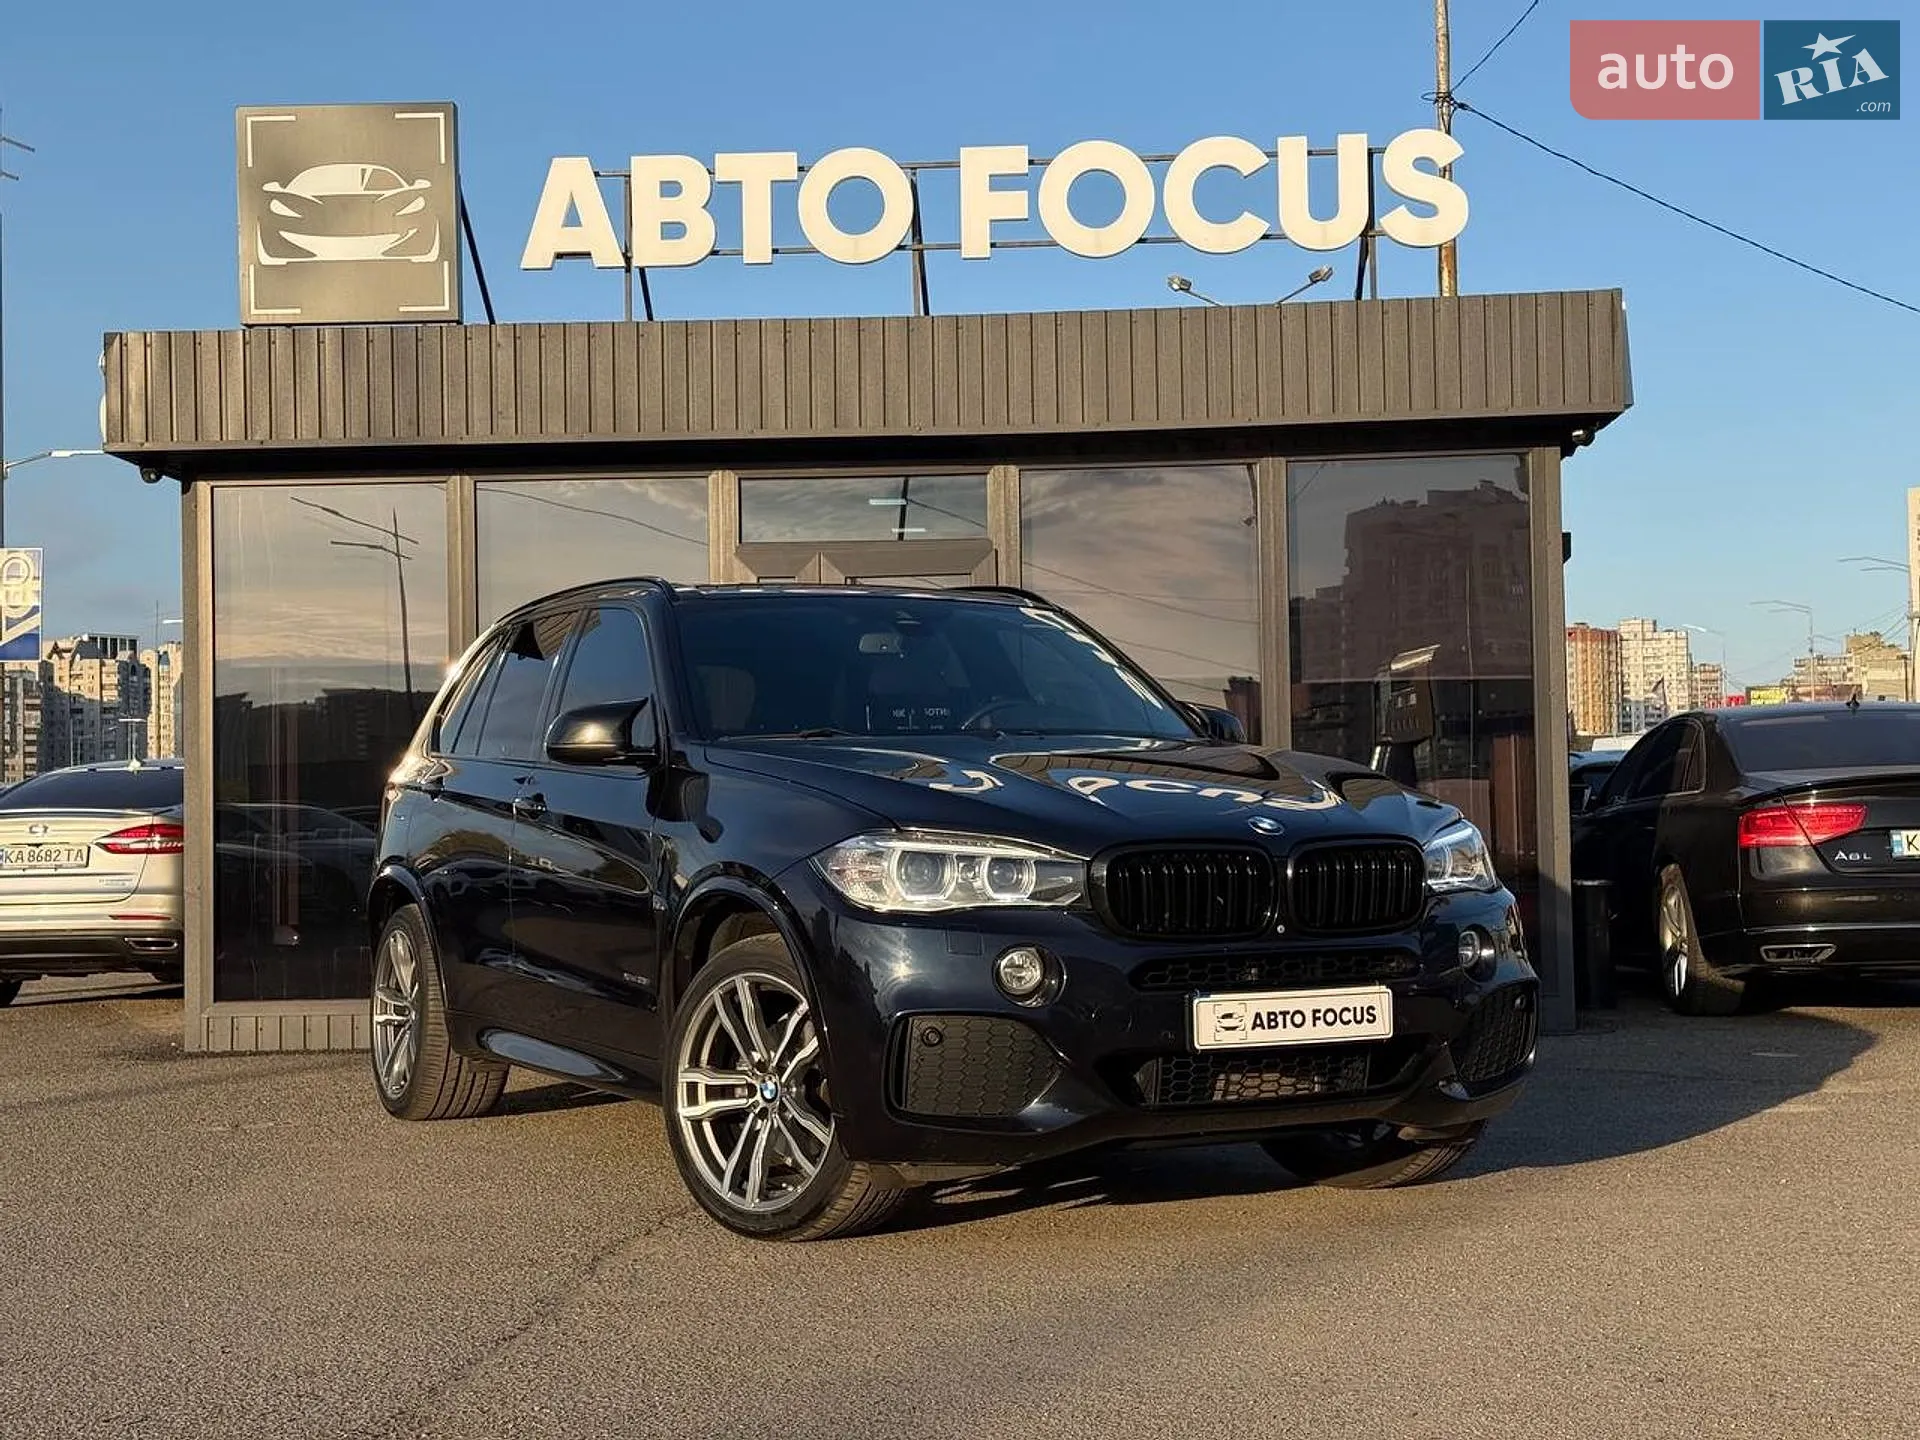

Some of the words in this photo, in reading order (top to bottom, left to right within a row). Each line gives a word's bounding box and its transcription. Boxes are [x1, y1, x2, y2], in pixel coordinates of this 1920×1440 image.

[519, 147, 915, 270] АВТО
[959, 128, 1470, 260] FOCUS
[4, 850, 24, 864] KA
[28, 849, 62, 863] 8682
[66, 848, 84, 863] TA
[1251, 1010, 1306, 1031] АВТО
[1312, 1005, 1377, 1027] FOCUS
